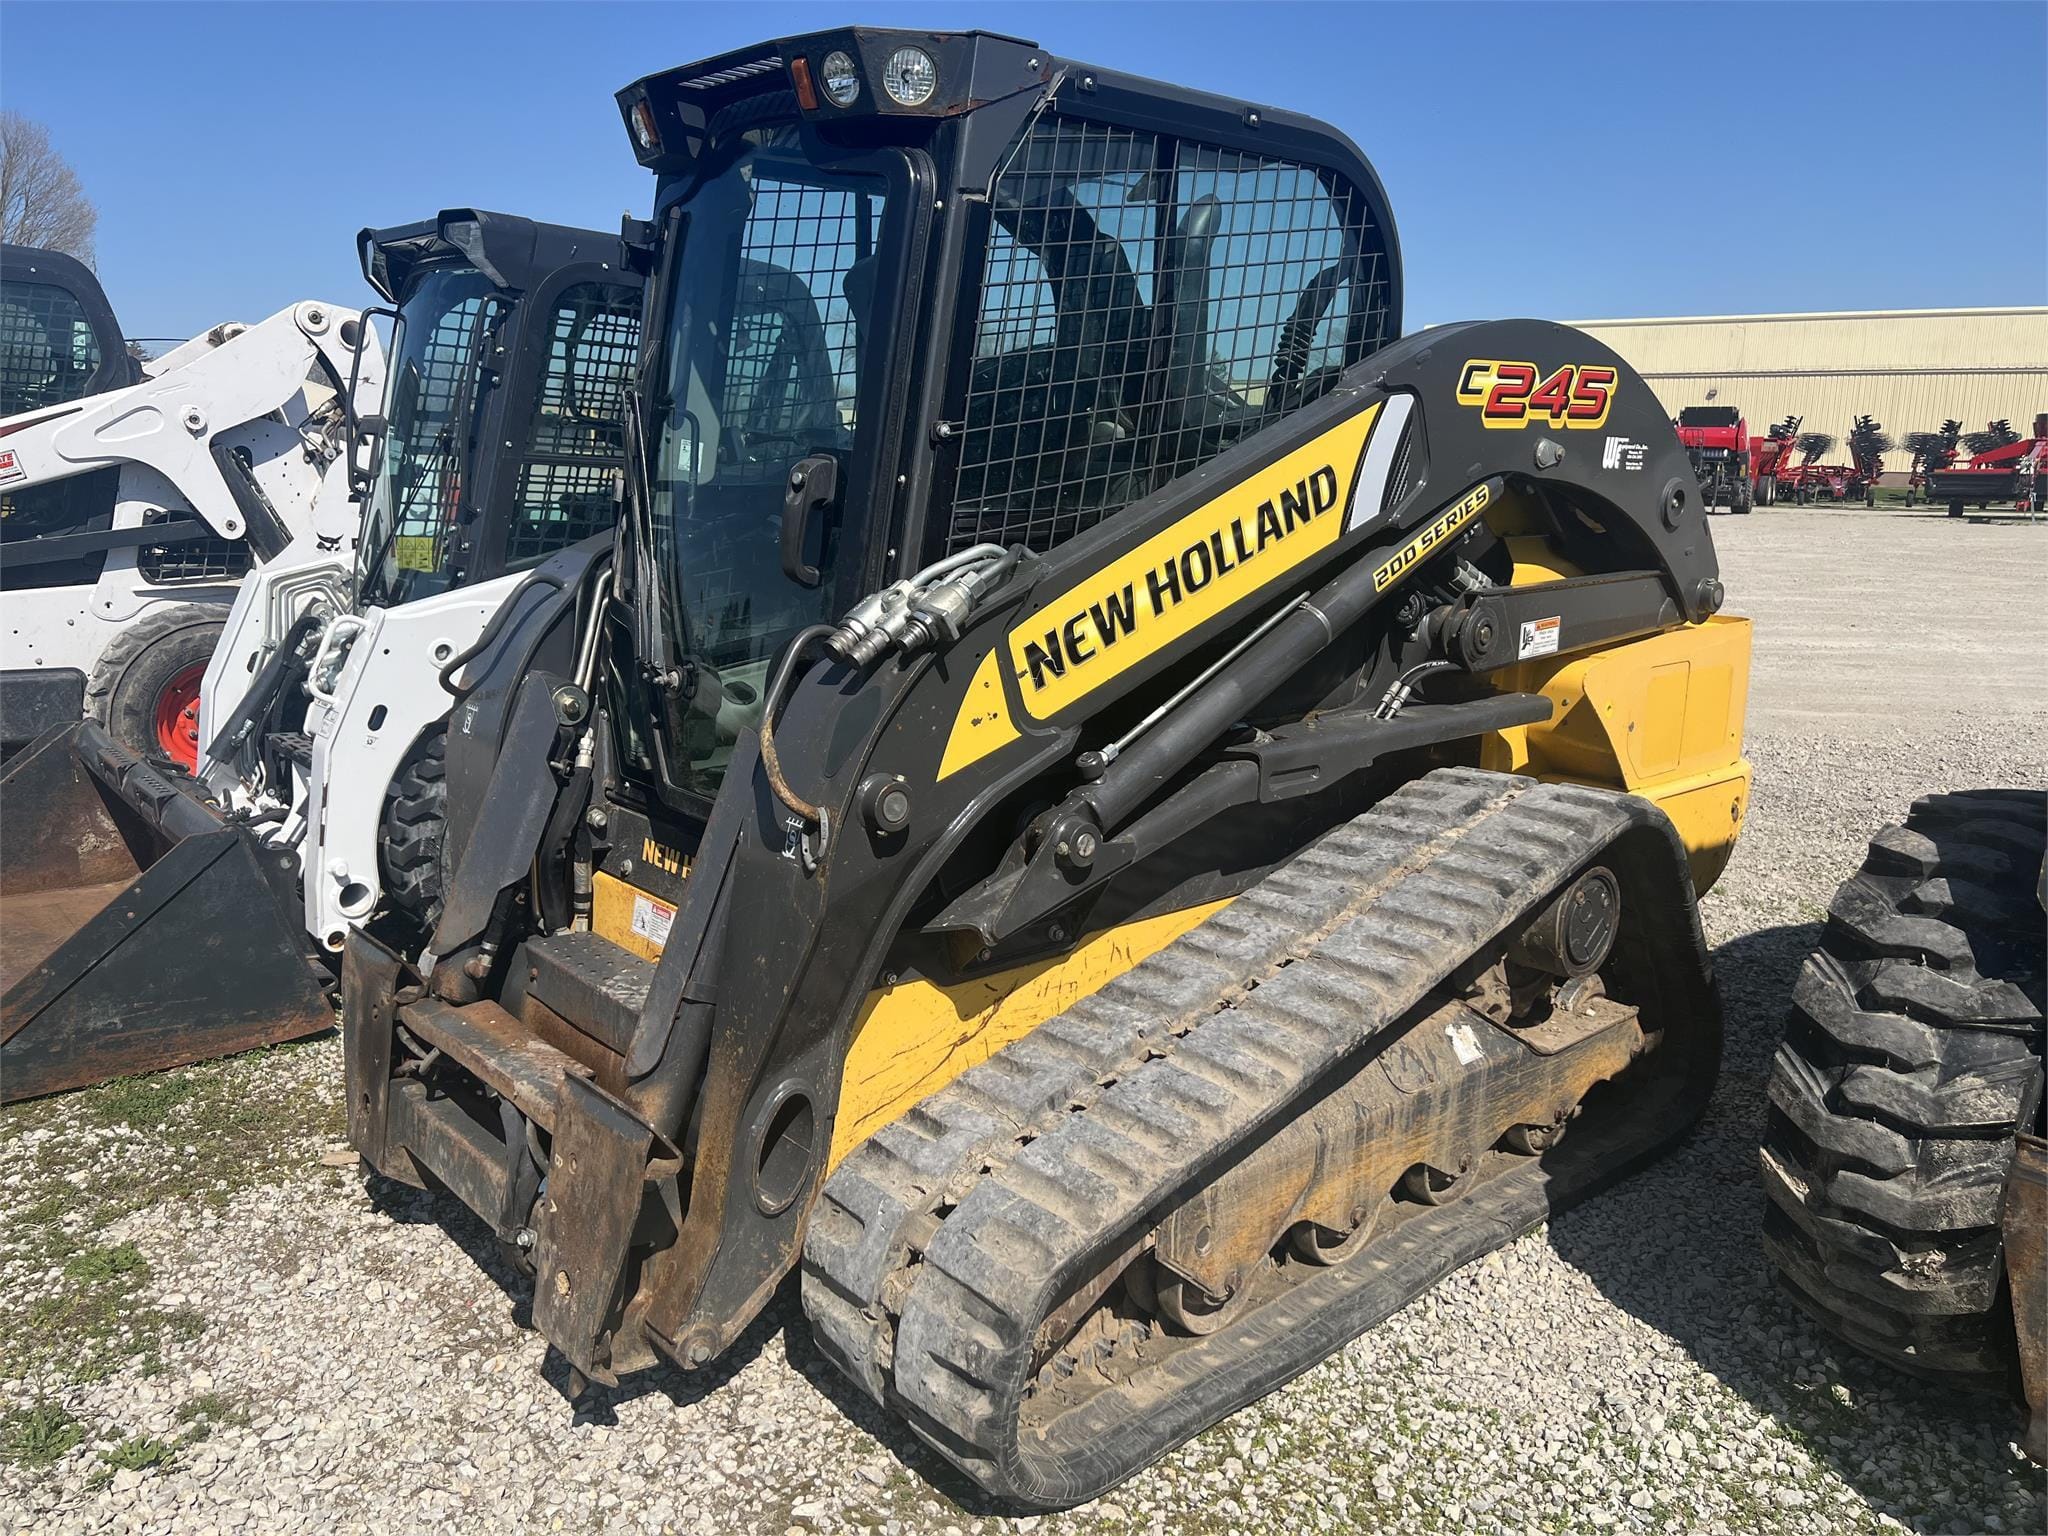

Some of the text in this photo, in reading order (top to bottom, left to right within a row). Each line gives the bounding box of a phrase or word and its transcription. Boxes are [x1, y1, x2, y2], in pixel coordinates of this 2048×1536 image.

[1457, 361, 1617, 424] C245
[1375, 487, 1487, 587] 200 SERIES
[1022, 464, 1338, 692] NEW HOLLAND
[642, 837, 681, 875] NEW
